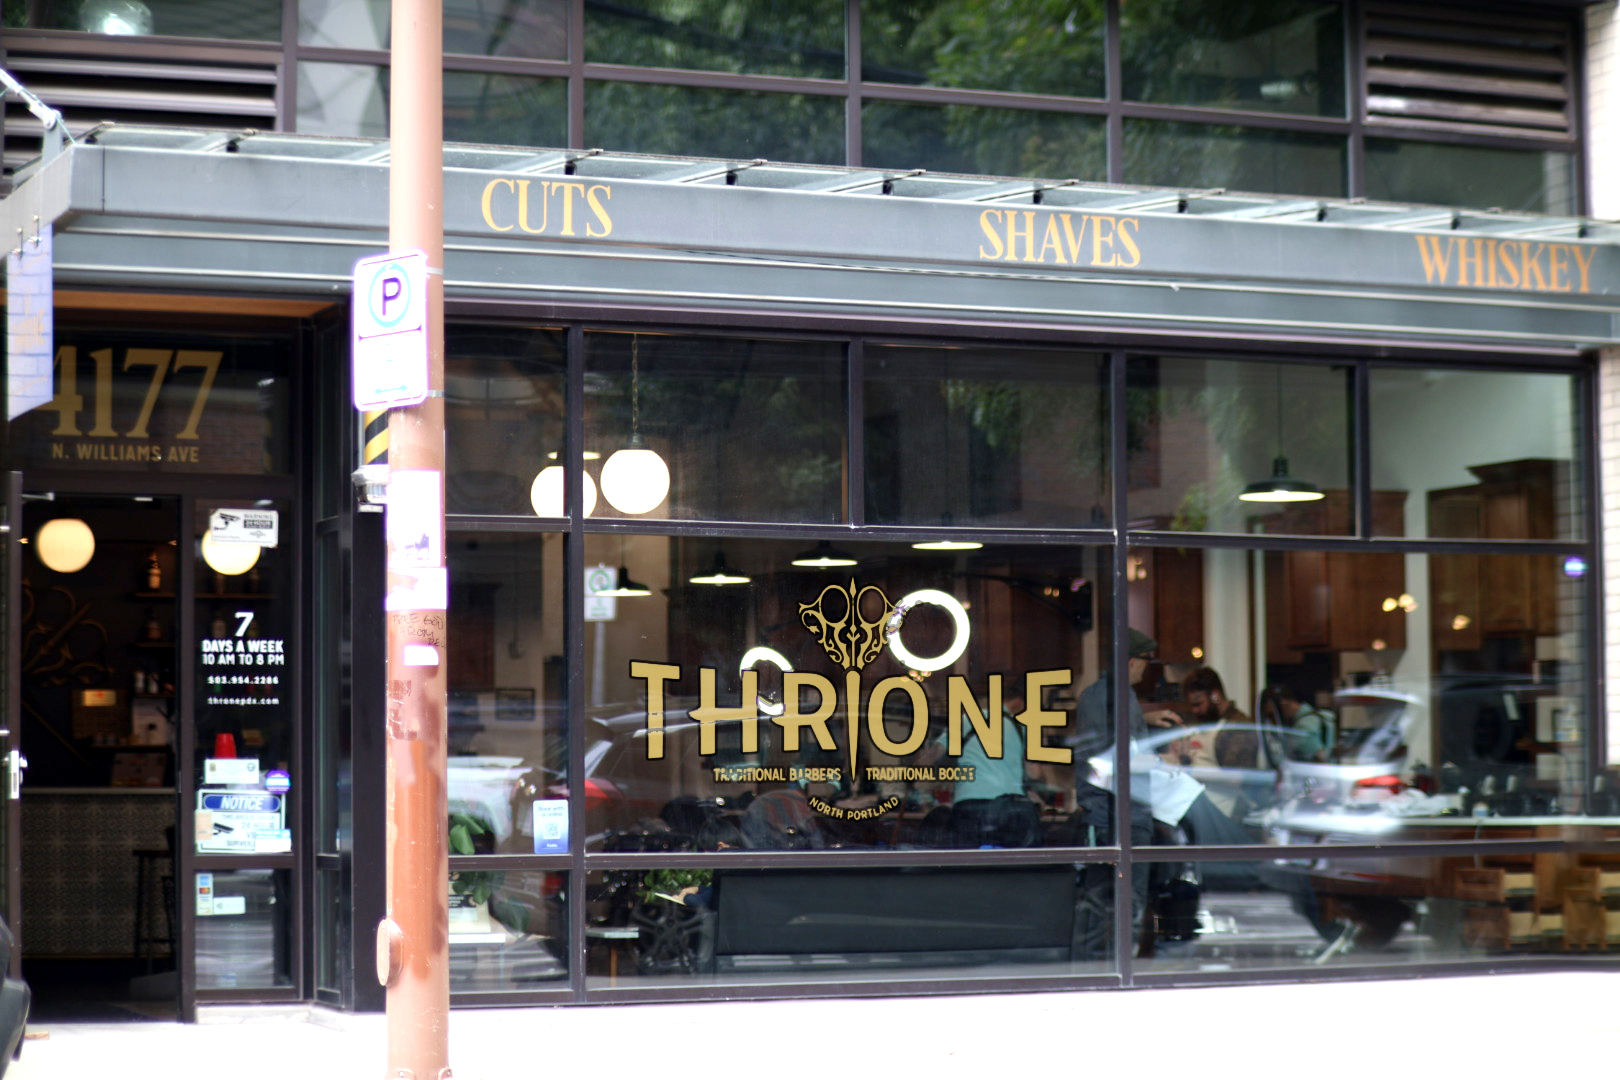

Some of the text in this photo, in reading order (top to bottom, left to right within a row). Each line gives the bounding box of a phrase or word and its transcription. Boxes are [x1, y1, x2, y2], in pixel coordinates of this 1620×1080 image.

[480, 178, 613, 239] CUTS
[978, 208, 1141, 269] SHAVES
[1415, 234, 1598, 295] WHISKEY
[382, 277, 402, 316] P
[34, 345, 224, 440] 4177
[52, 443, 200, 463] N. WILLIAMS AVE
[234, 611, 254, 637] 7
[202, 640, 284, 653] DAYS A WEEK
[202, 654, 285, 665] 10 AM TO 8 PM
[631, 661, 1072, 764] THRONE
[713, 767, 842, 781] TRADITIONAL BARBERS
[865, 767, 936, 781] TRADITIONAL
[220, 796, 264, 811] NOTICE
[809, 796, 899, 820] NORTH PORTLAND
